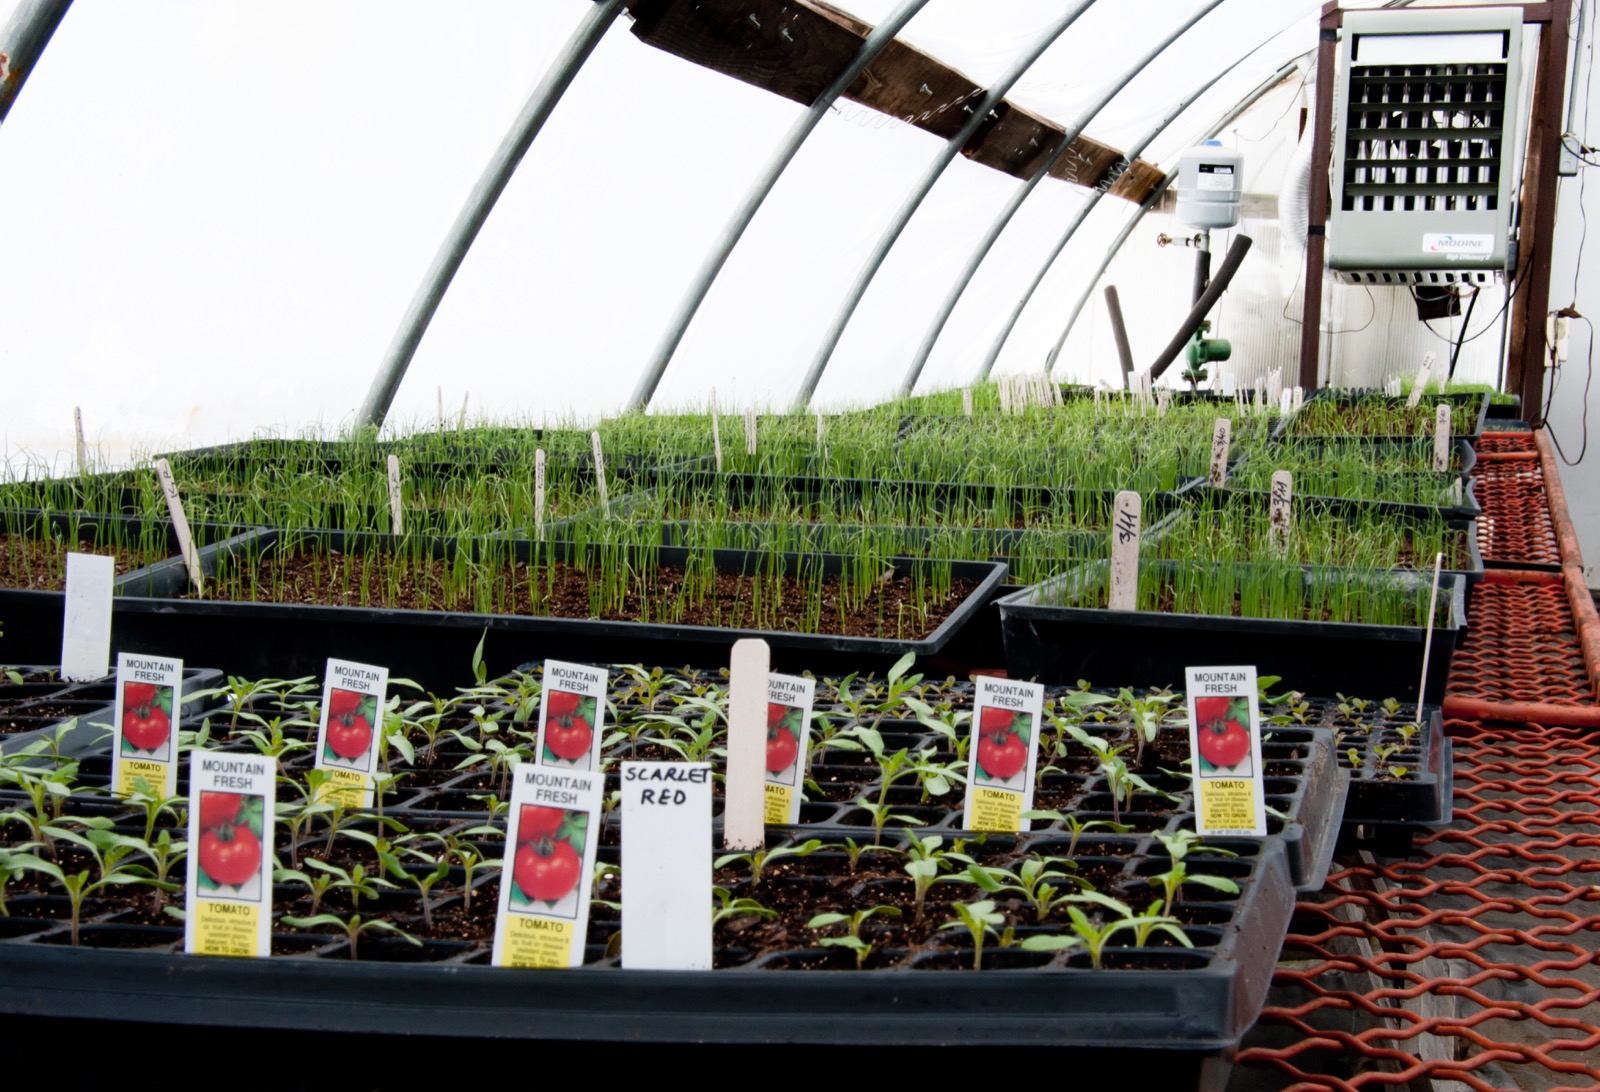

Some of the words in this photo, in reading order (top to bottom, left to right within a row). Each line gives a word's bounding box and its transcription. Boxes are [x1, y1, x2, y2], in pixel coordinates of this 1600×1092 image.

[1437, 240, 1485, 248] MODINE
[126, 659, 174, 673] MOUNTAIN
[134, 672, 165, 682] FRESH
[334, 665, 380, 682] MOUNTAIN
[551, 667, 599, 683] MOUNTAIN
[1194, 672, 1247, 682] MOUNTAIN
[341, 678, 371, 691] FRESH
[559, 679, 589, 692] FRESH
[769, 680, 806, 694] UNTAIN
[984, 683, 1034, 698] MOUNTAIN
[1204, 684, 1237, 693] FRESH
[992, 696, 1024, 708] FRESH
[129, 762, 162, 772] TOMATO
[202, 760, 264, 775] MOUNTAIN
[213, 775, 253, 789] FRESH
[525, 773, 592, 791] MOUNTAIN
[625, 767, 712, 784] SCARLET
[1210, 781, 1245, 789] TOMATO
[536, 789, 577, 804] FRESH
[641, 788, 687, 805] RED
[982, 789, 1016, 802] TOMATO
[209, 903, 250, 916] TOMATO
[519, 917, 564, 933] TOMATO
